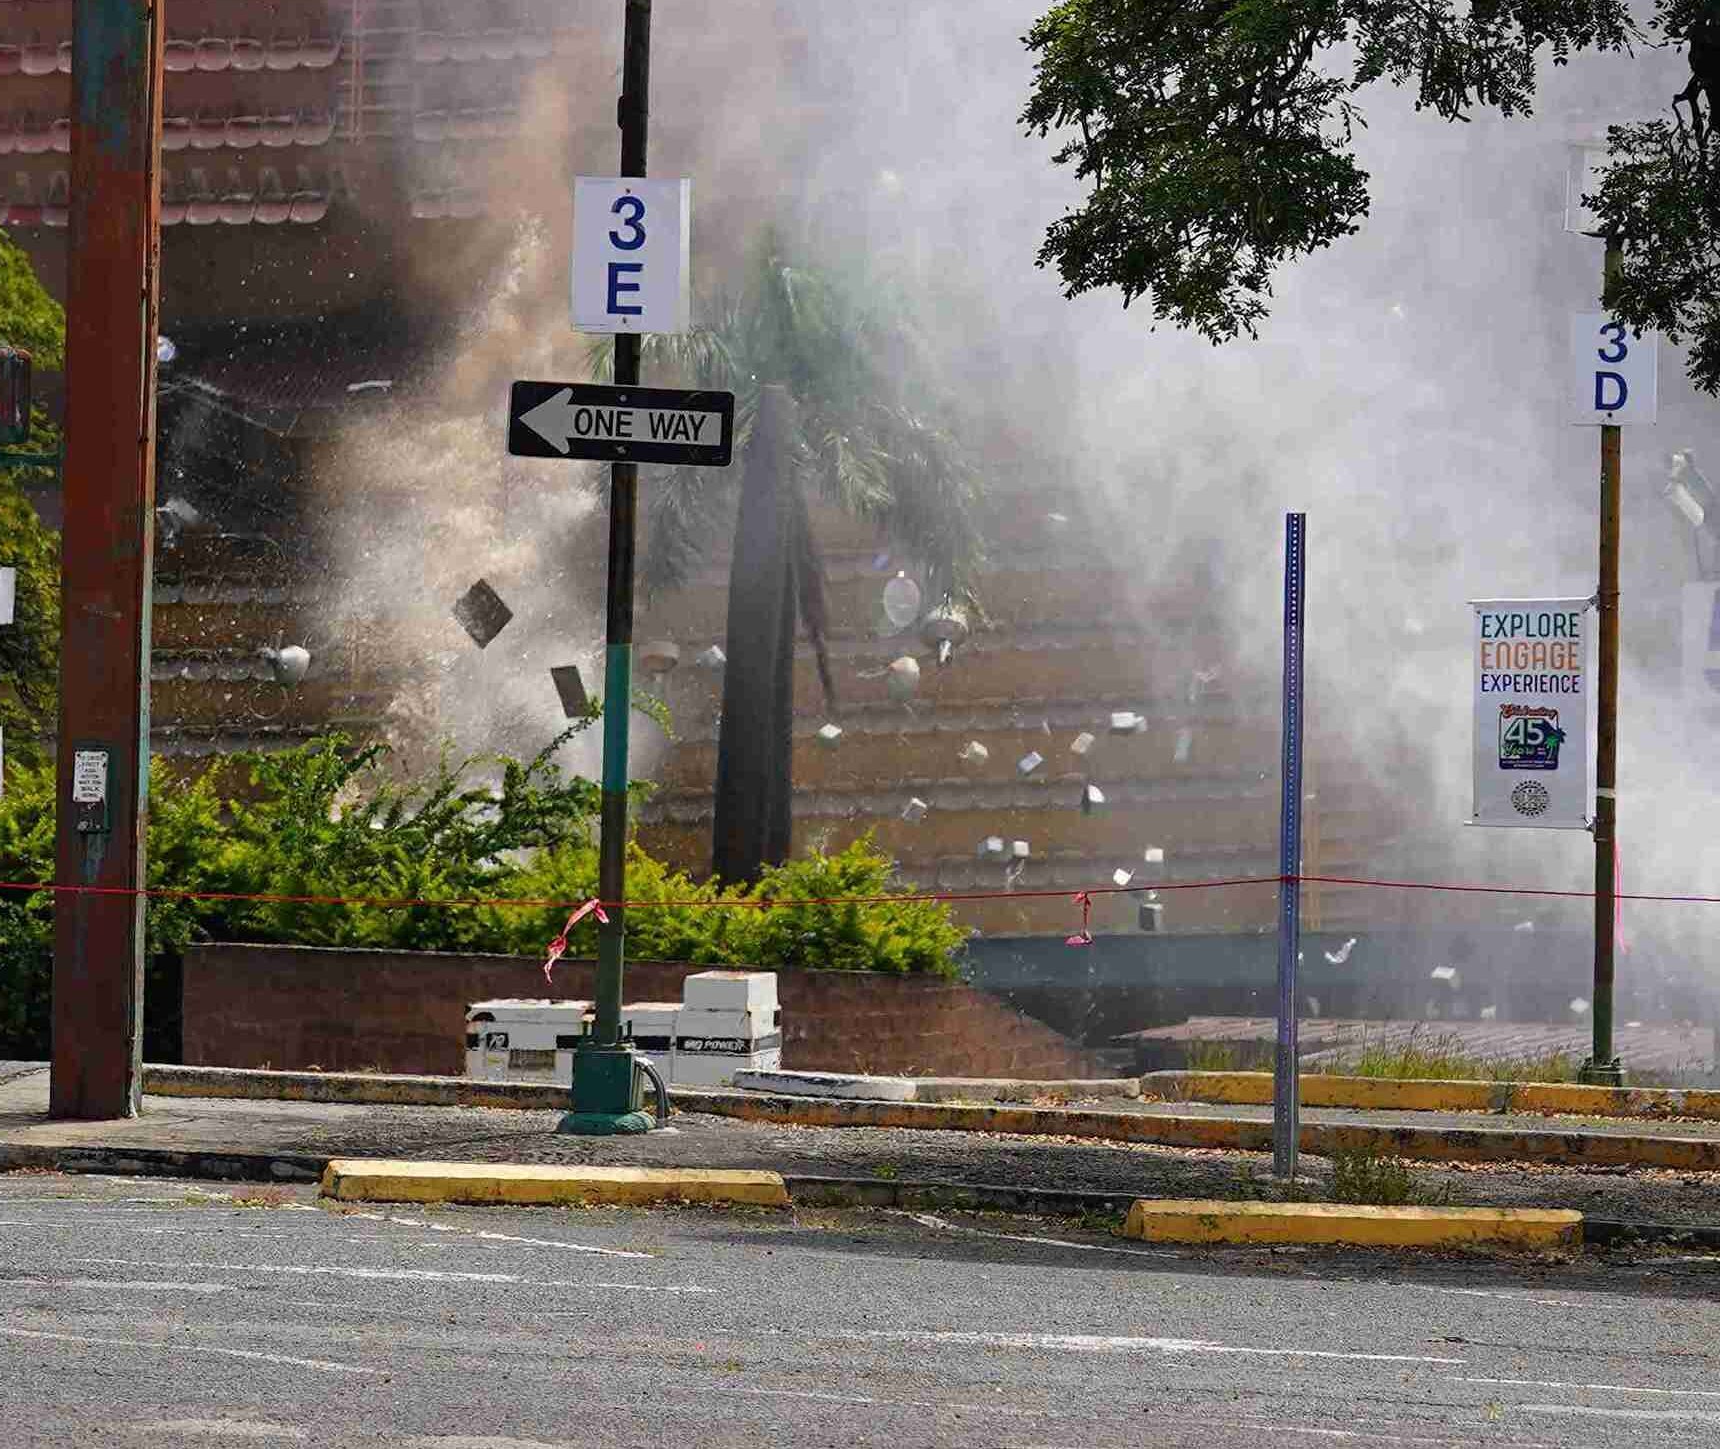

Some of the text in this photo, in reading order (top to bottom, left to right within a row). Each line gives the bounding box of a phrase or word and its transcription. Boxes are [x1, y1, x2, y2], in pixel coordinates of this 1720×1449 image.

[608, 196, 647, 251] 3
[607, 262, 643, 315] E
[1597, 322, 1628, 363] 3
[1595, 372, 1628, 411] D
[574, 408, 706, 441] ONE WAY
[1481, 612, 1580, 638] EXPLORE
[1481, 641, 1580, 670] ENGAGE
[1481, 674, 1580, 693] EXPERIENCE
[1504, 717, 1545, 745] 45
